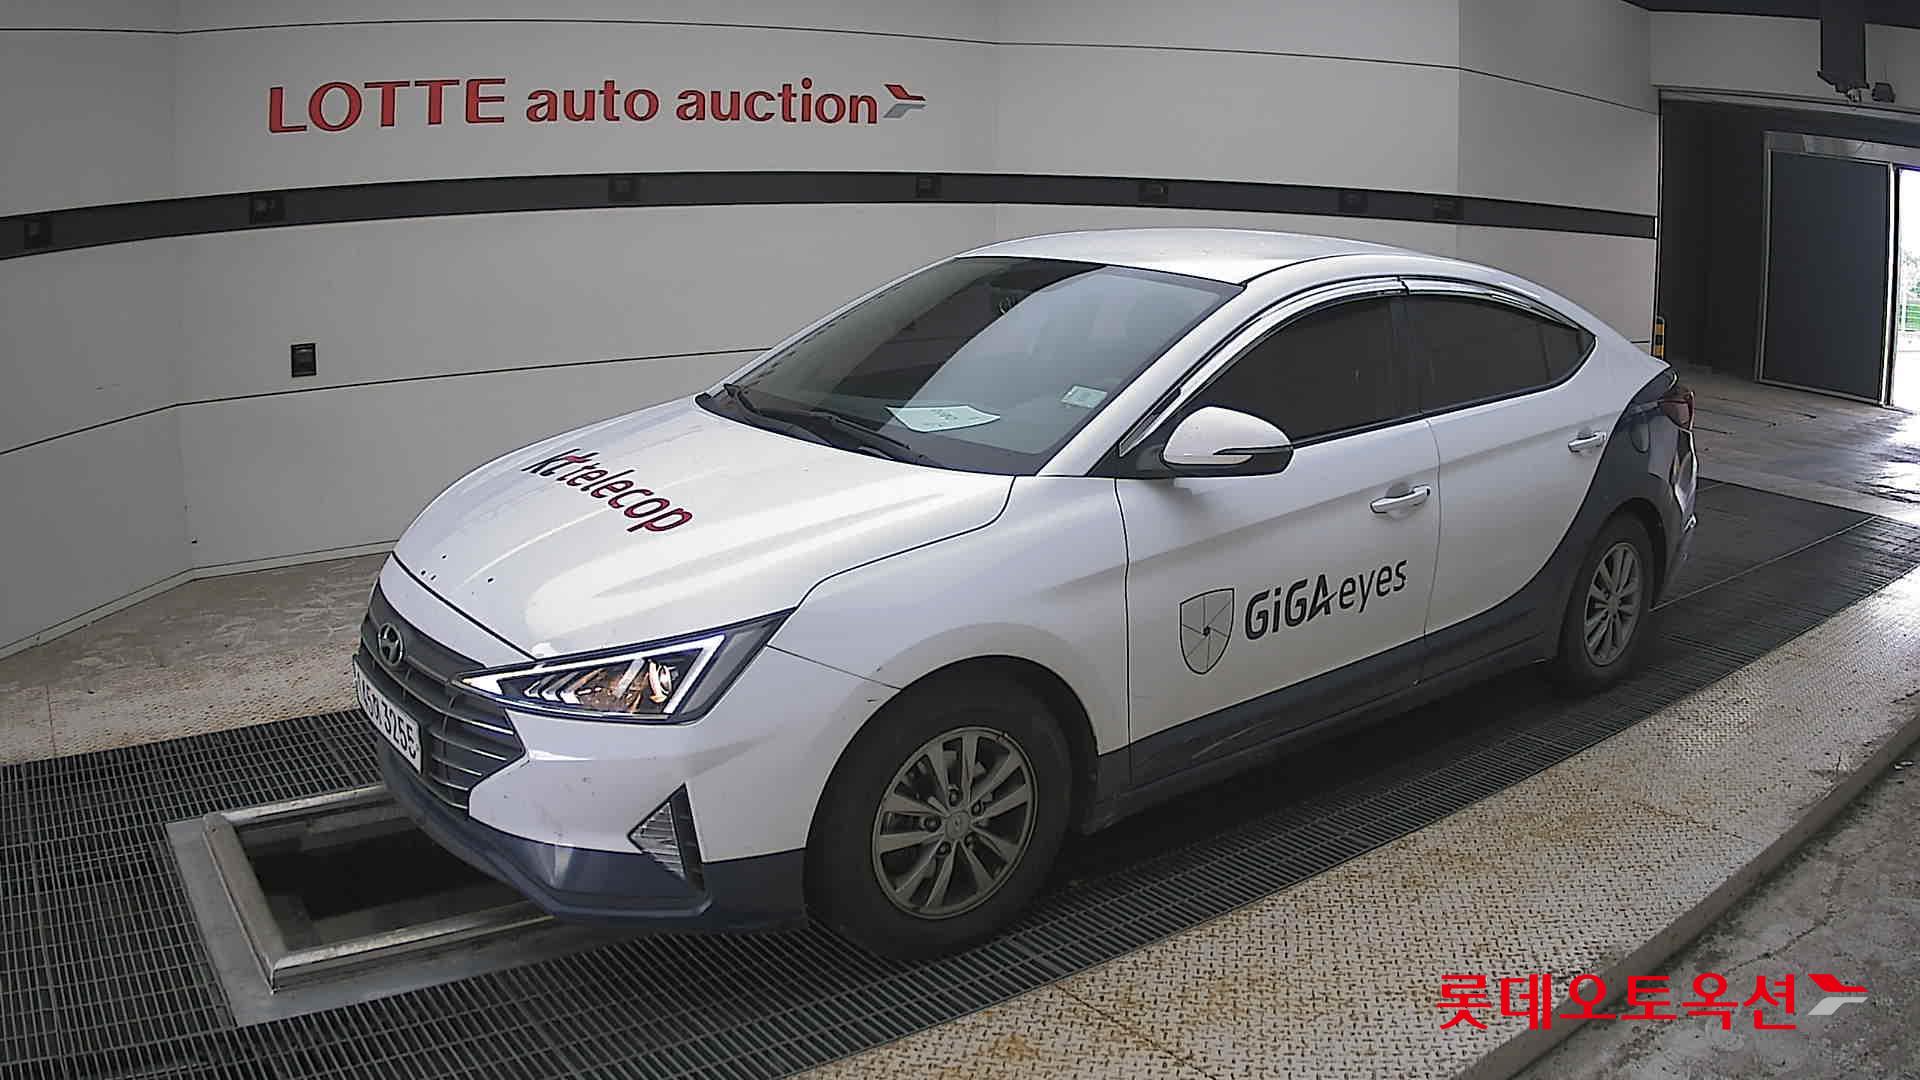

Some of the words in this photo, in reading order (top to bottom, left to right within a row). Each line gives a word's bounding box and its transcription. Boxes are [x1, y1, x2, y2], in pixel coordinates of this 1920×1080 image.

[268, 77, 506, 133] LOTTE
[525, 79, 660, 123] auto
[675, 77, 878, 124] auction
[556, 462, 693, 533] telecop
